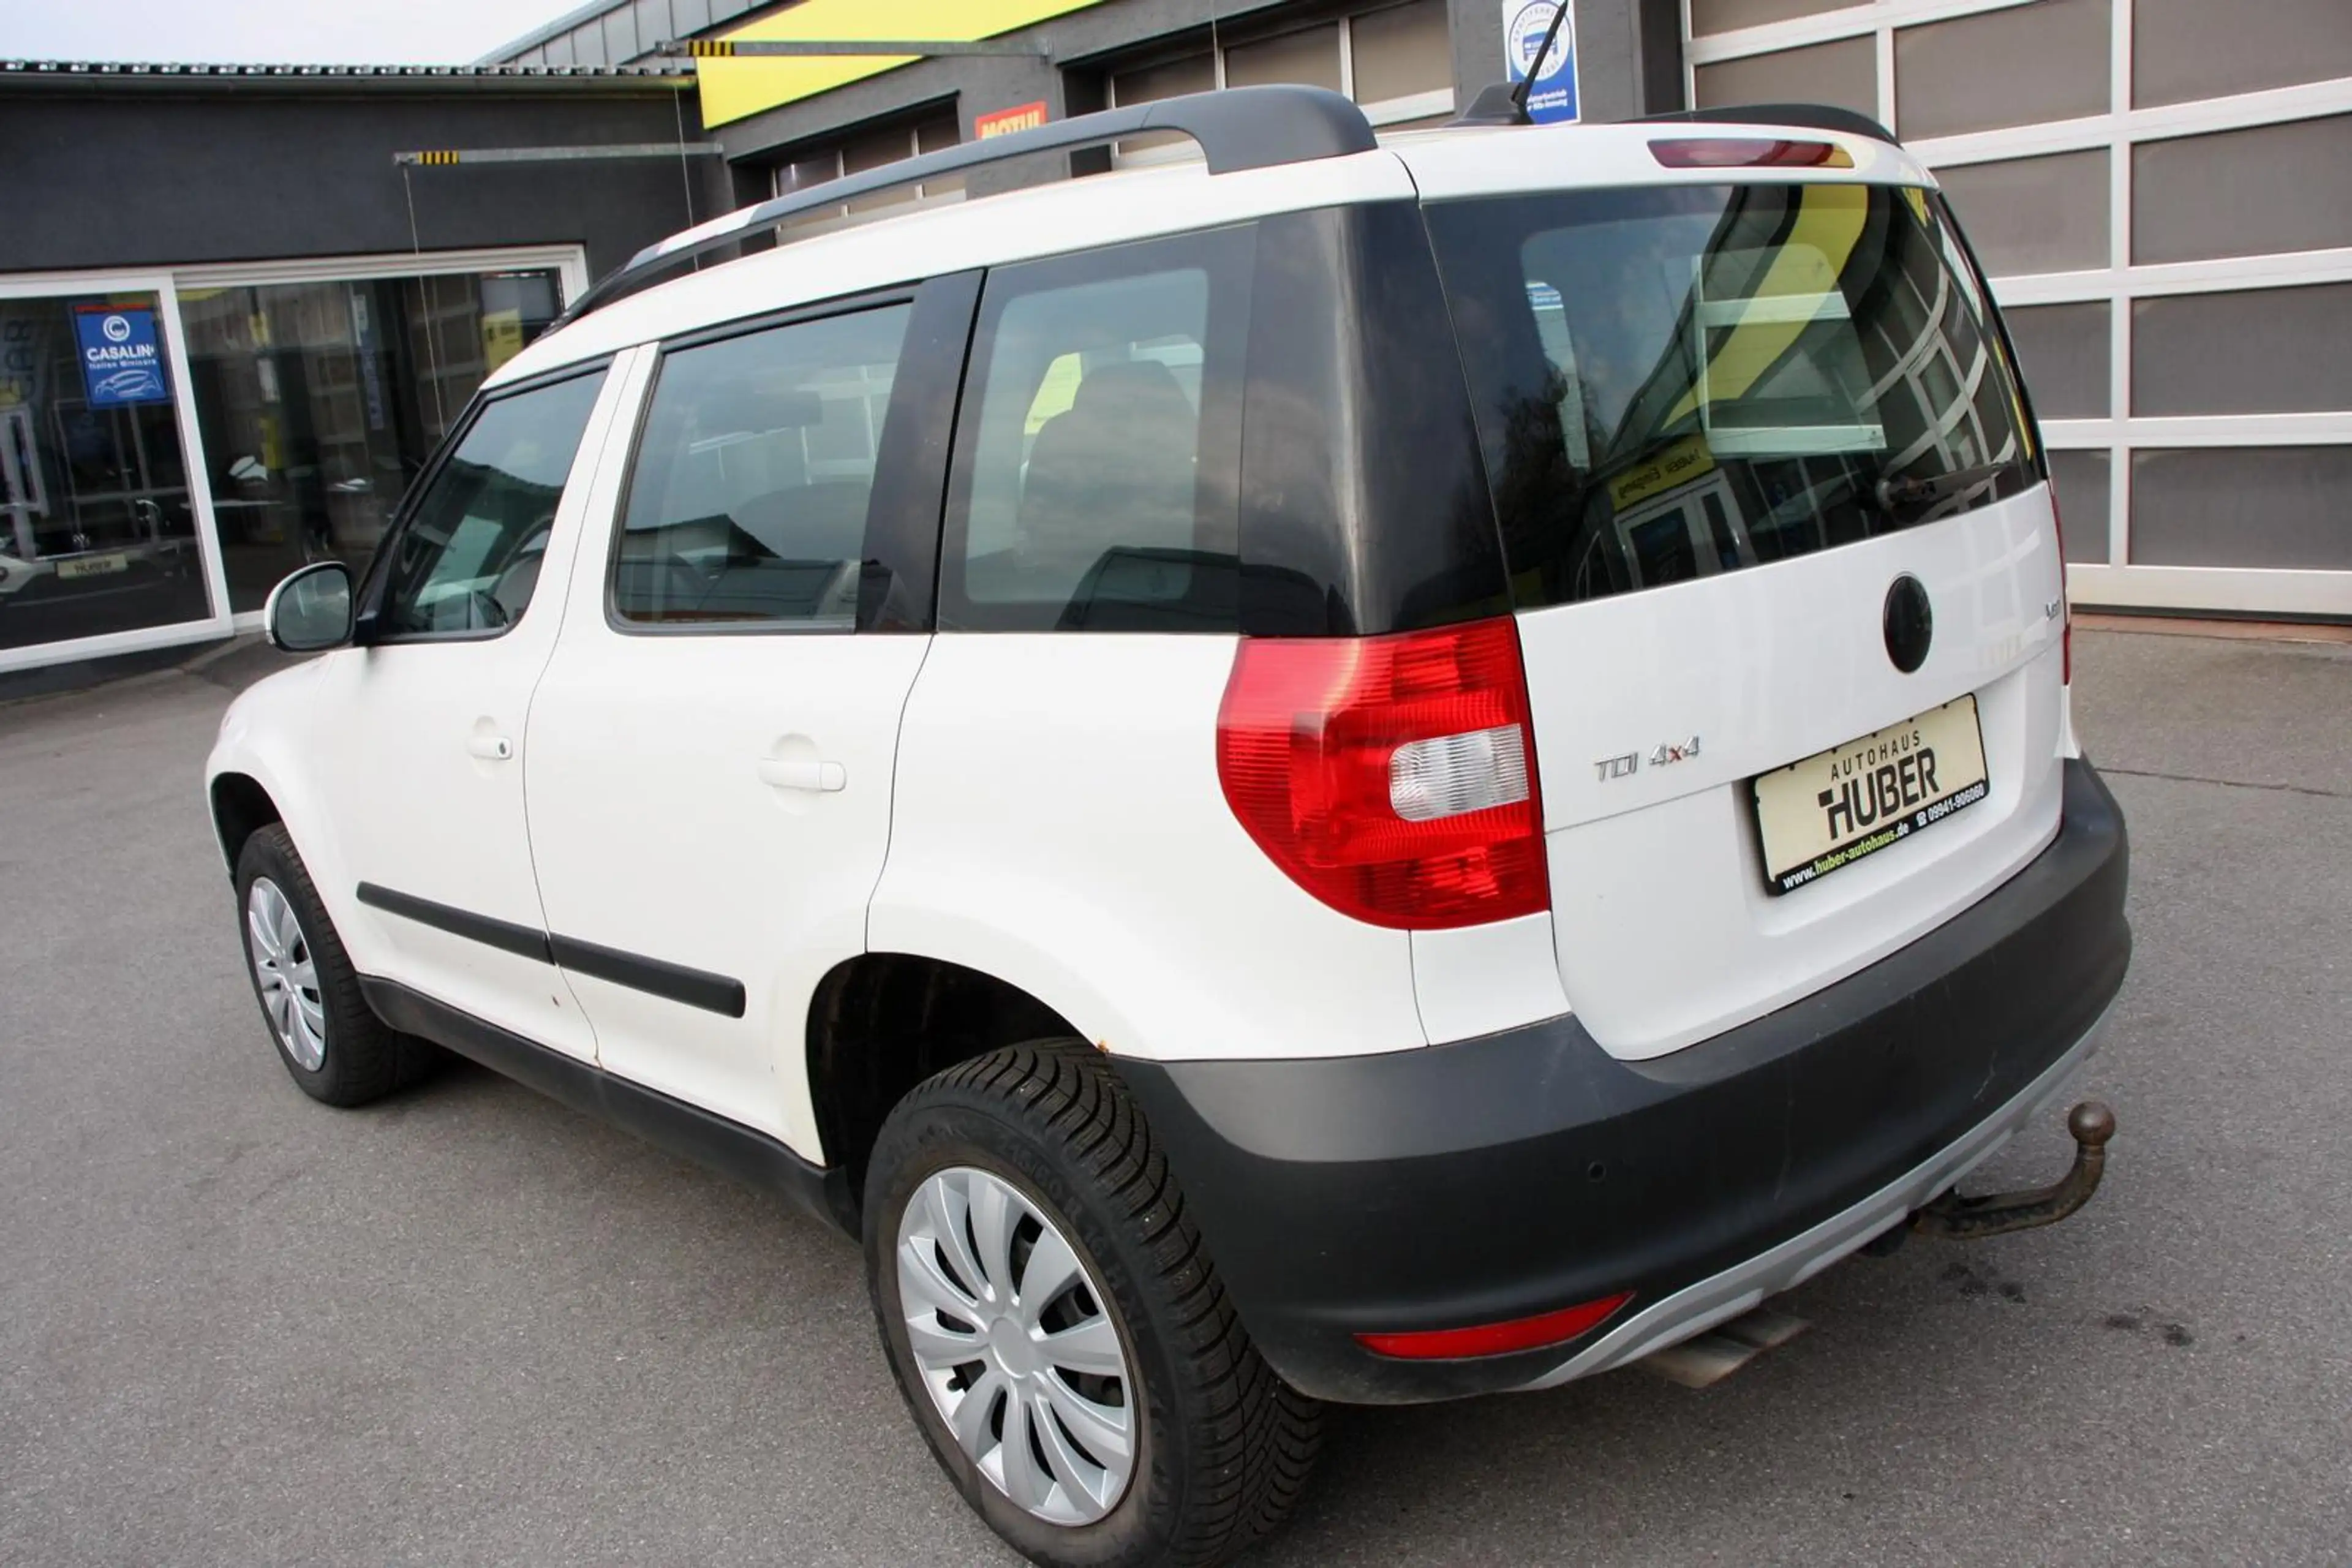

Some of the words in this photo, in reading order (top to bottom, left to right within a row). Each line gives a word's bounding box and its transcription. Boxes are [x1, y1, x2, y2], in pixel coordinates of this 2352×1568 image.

[1594, 752, 1638, 782] TDI
[1648, 734, 1699, 766] 4x4
[1831, 730, 1921, 781] AUTOHAUS
[1817, 746, 1940, 841] HUBER
[1783, 823, 1909, 889] www.huber-autohaus.de
